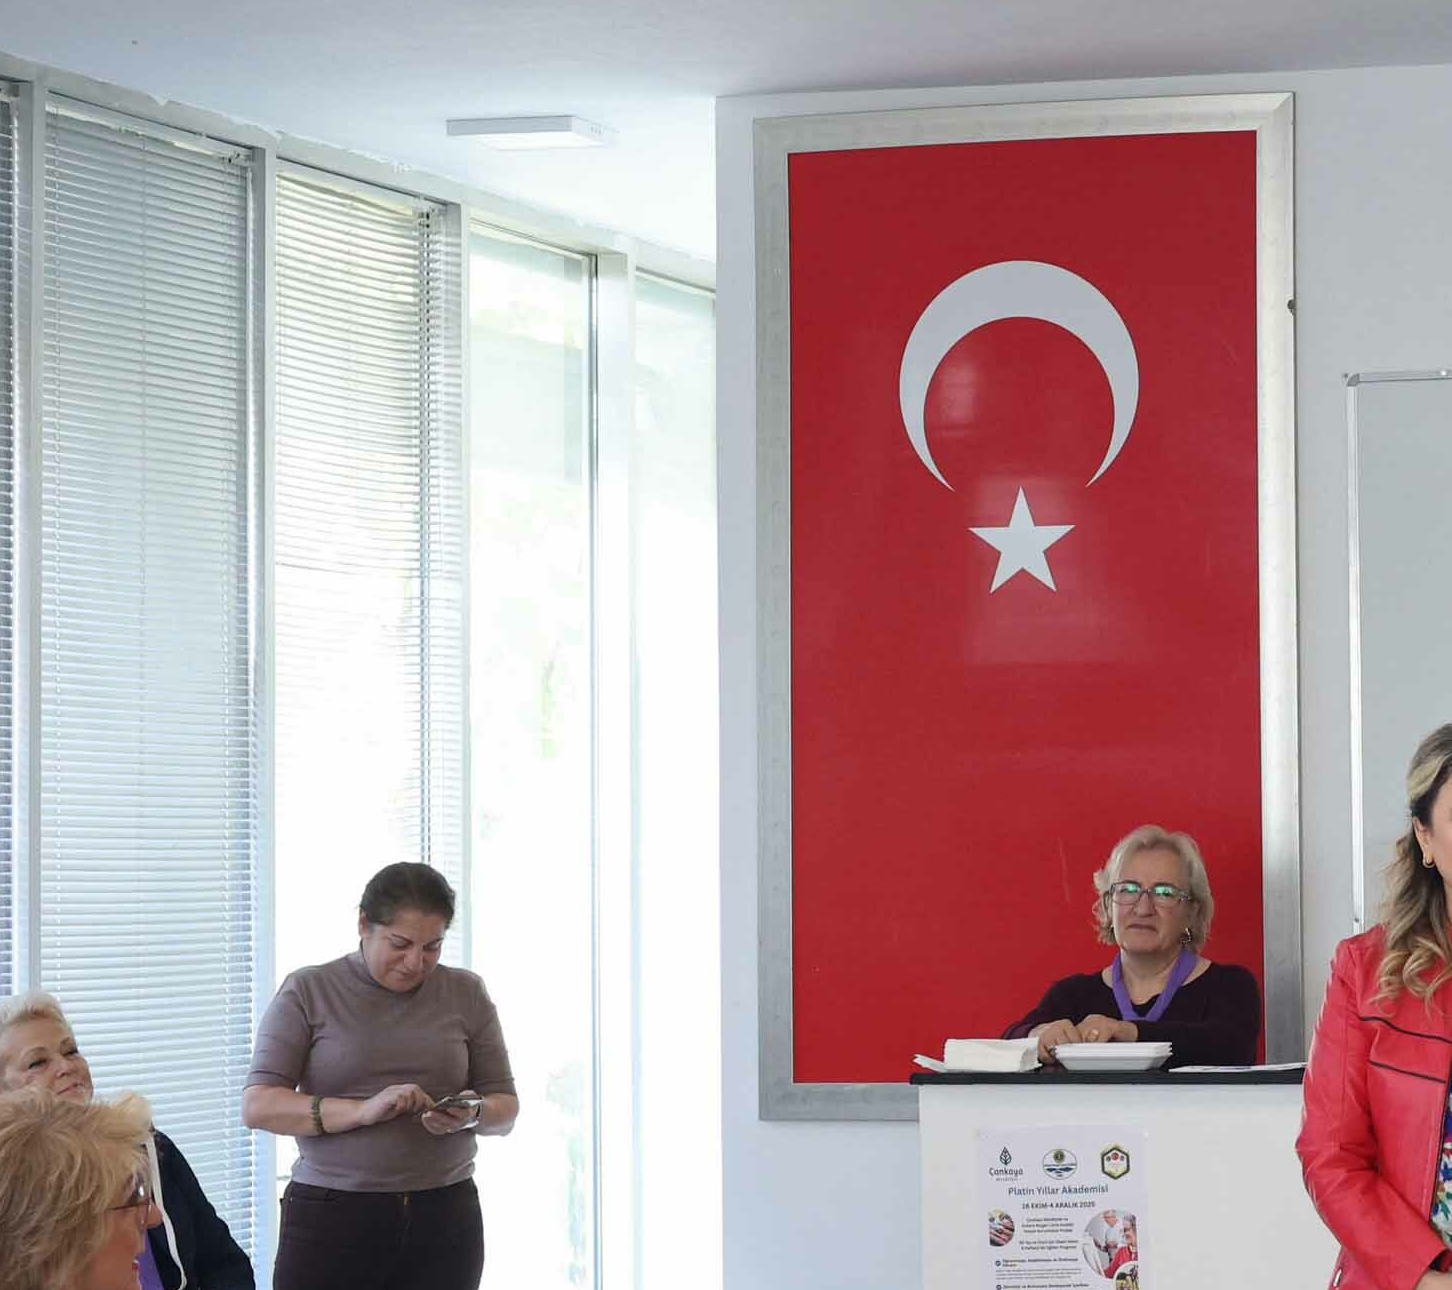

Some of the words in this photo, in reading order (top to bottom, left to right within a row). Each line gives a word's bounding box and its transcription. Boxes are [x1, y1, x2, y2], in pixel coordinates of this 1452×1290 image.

[1008, 1186, 1035, 1196] Platin
[1036, 1186, 1059, 1195] Yıllar
[1061, 1184, 1109, 1195] Akademisi
